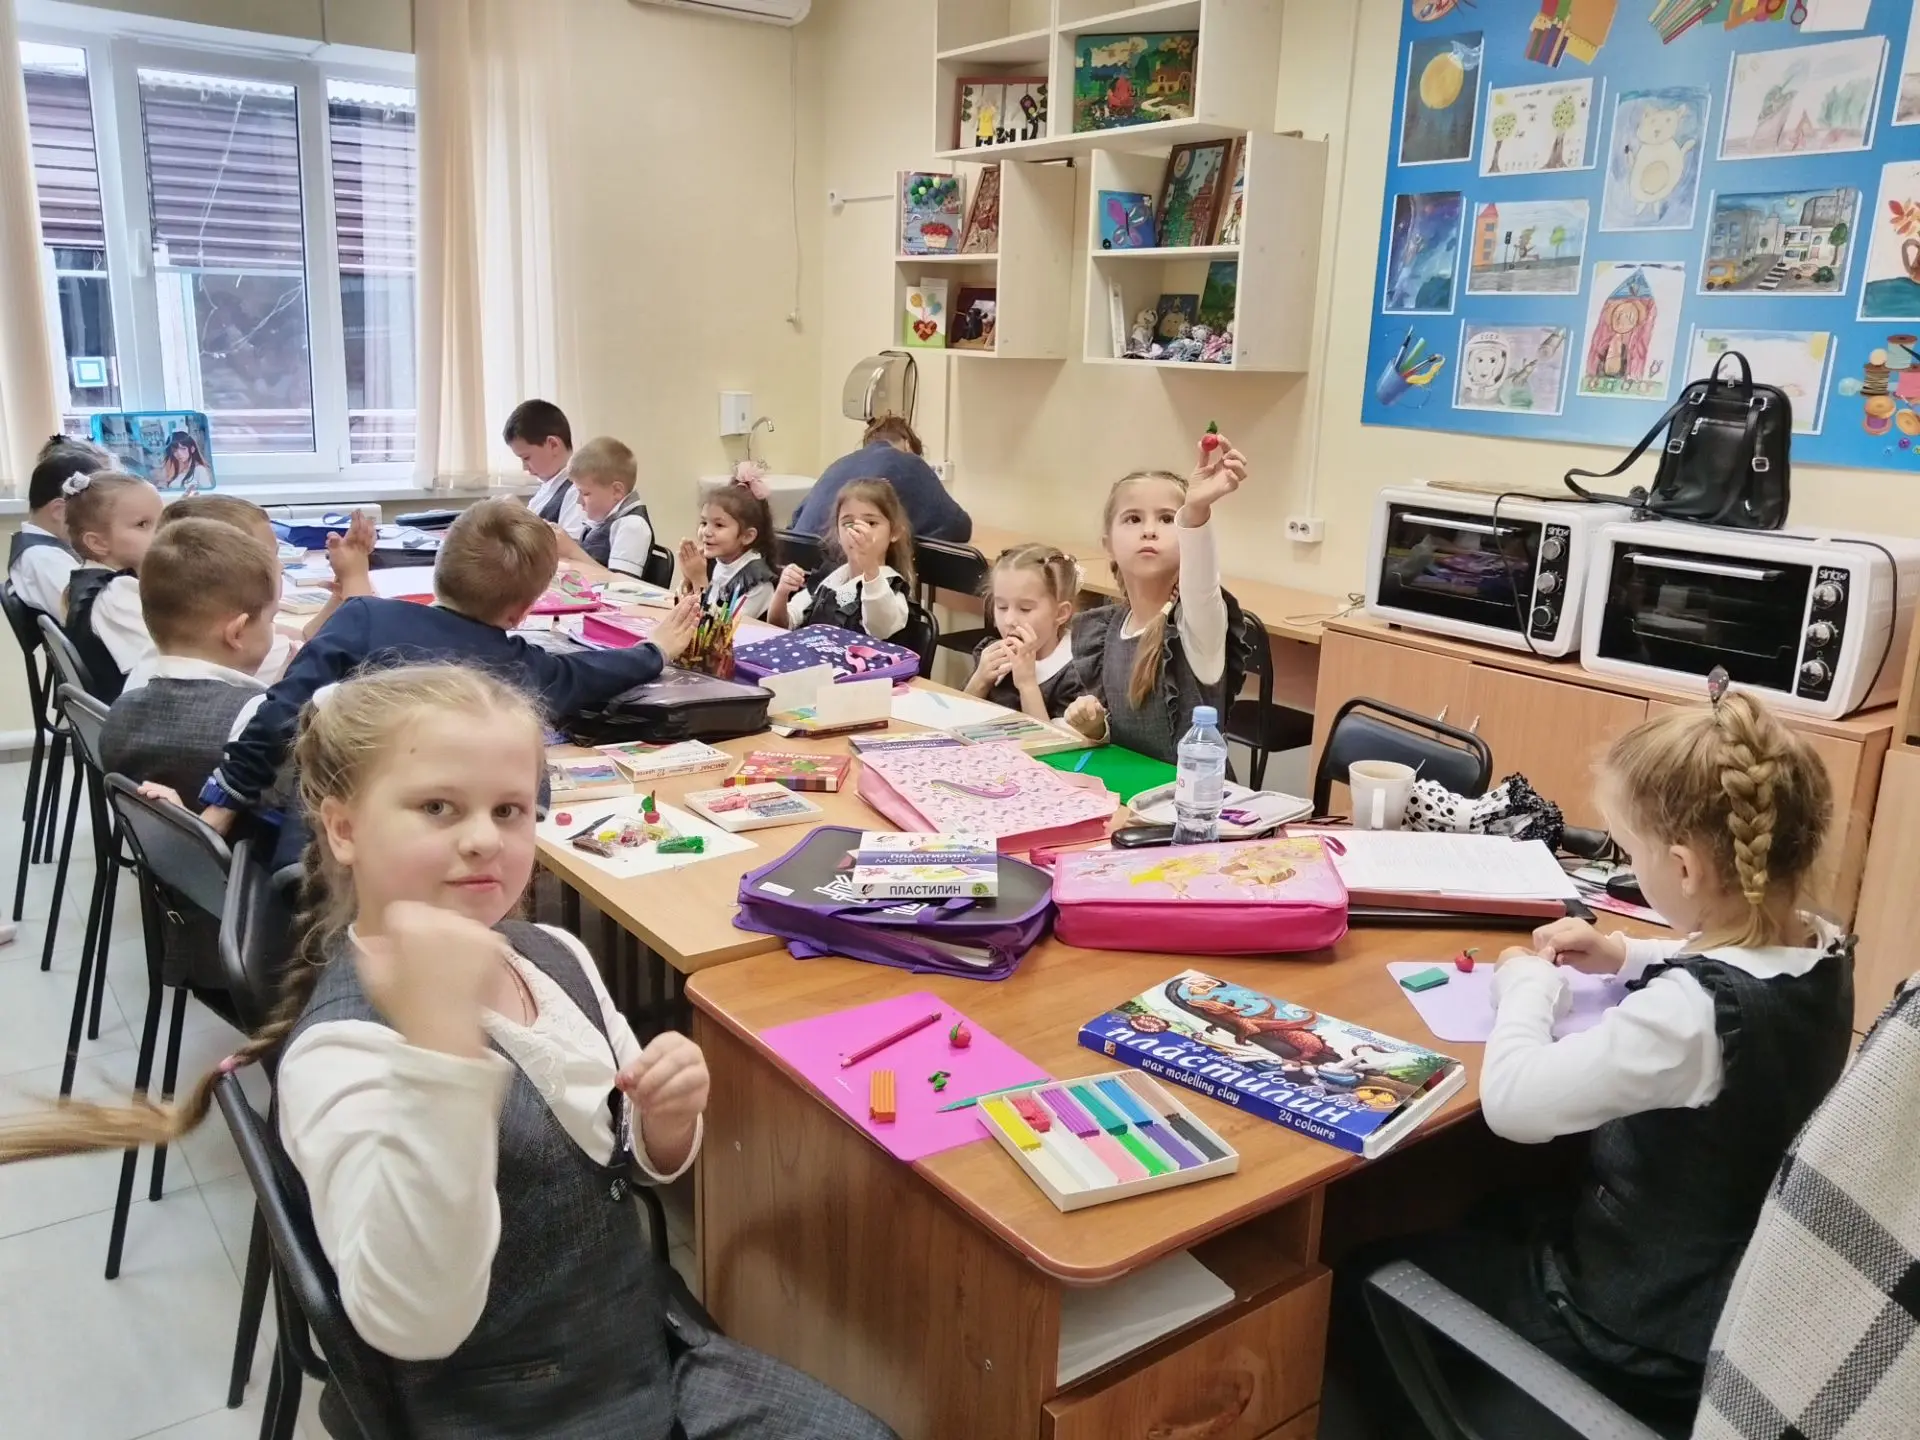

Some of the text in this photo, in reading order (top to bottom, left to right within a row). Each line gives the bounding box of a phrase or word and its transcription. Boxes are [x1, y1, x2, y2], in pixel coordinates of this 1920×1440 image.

[889, 885, 962, 896] ПЛАСТИЛИН
[1105, 1027, 1351, 1123] пластилин
[1177, 1041, 1254, 1073] 24 цвета
[1142, 1058, 1240, 1105] wax modelling clay
[1258, 1070, 1370, 1112] восковой
[1278, 1109, 1336, 1140] 24 colours
